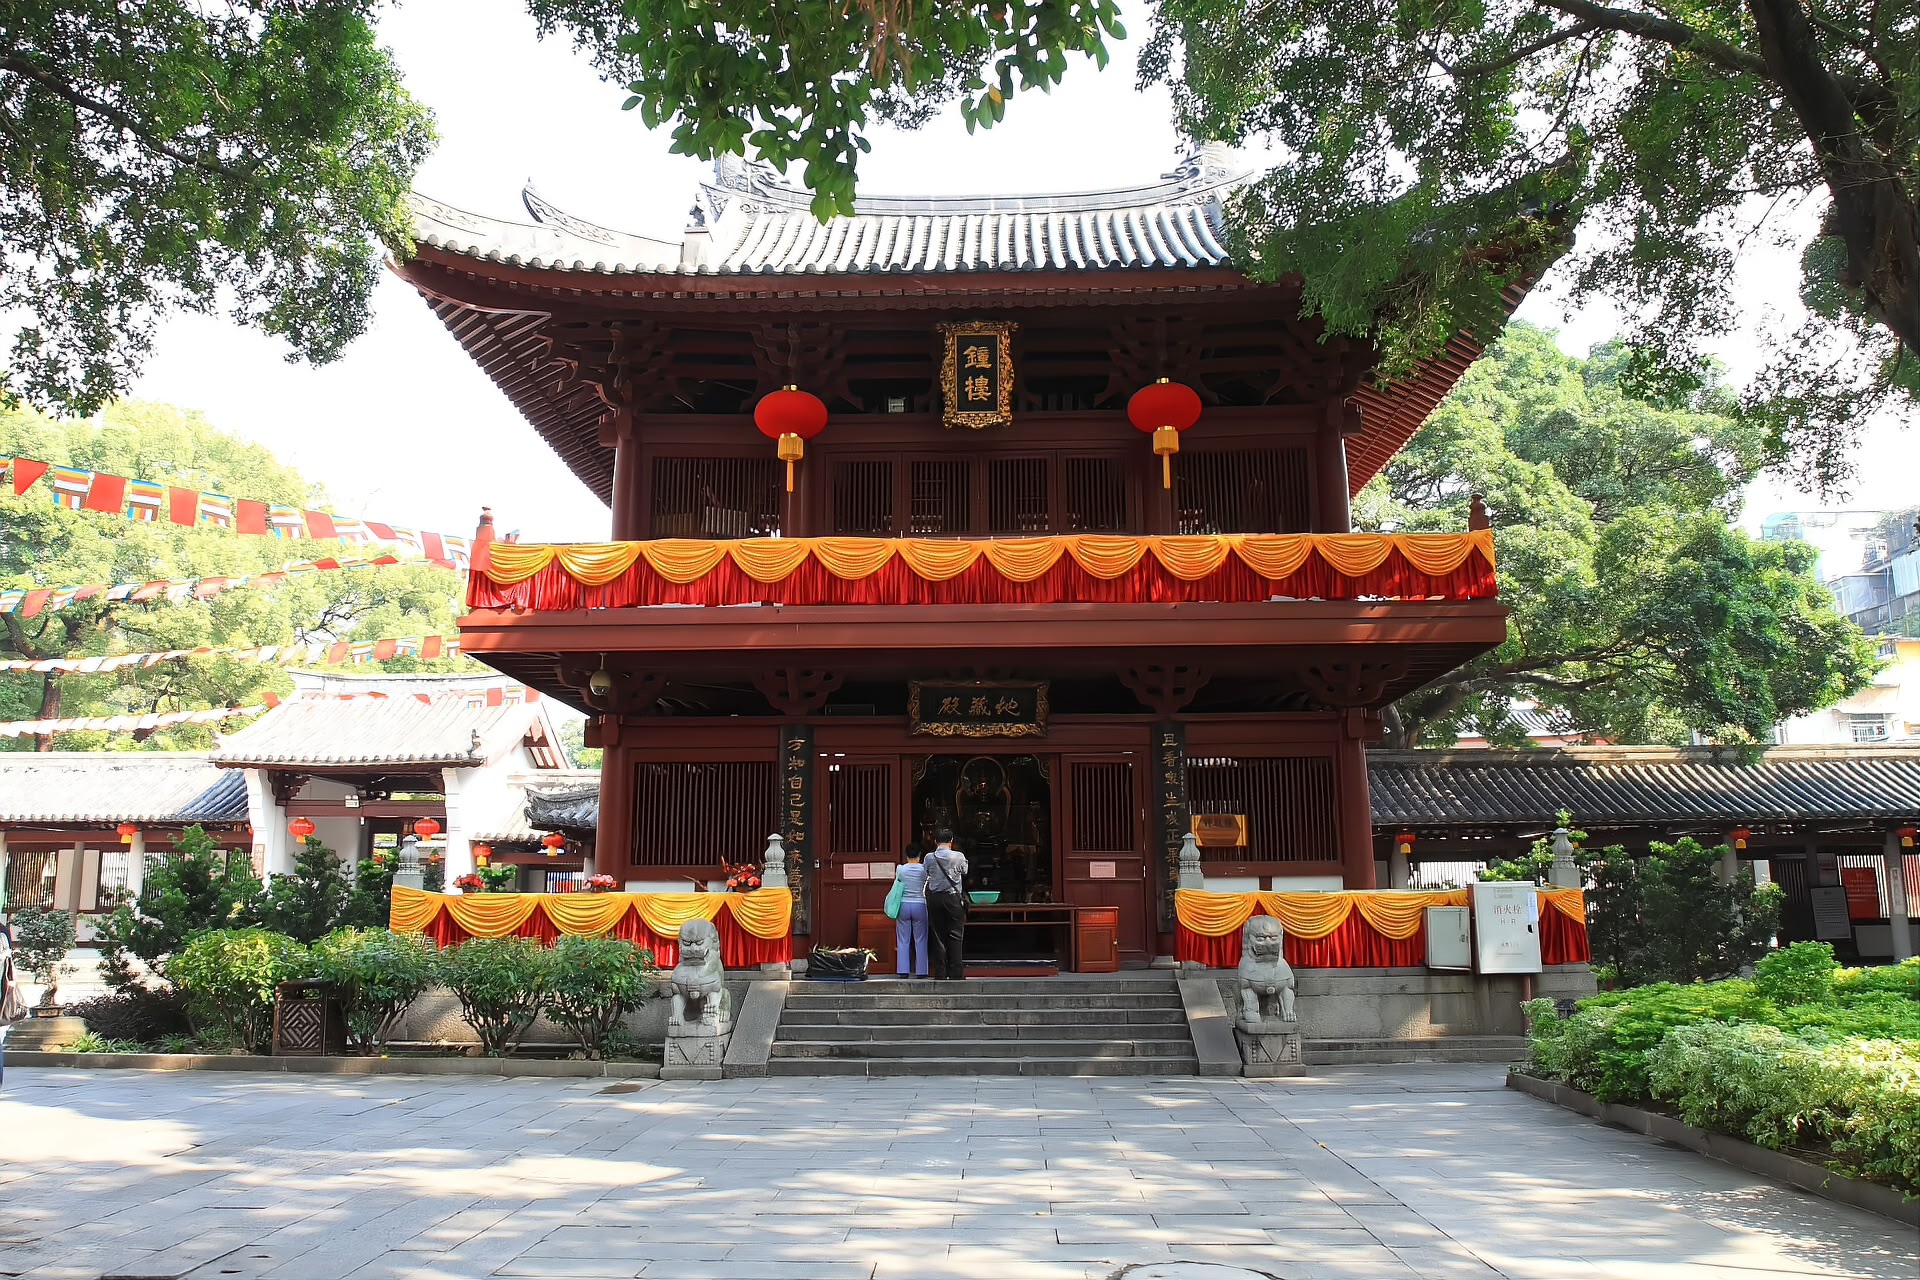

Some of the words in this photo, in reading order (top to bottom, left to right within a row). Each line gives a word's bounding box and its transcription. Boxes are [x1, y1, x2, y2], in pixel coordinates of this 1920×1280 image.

[962, 345, 992, 401] 鐘樓
[937, 695, 1021, 716] 地藏殿
